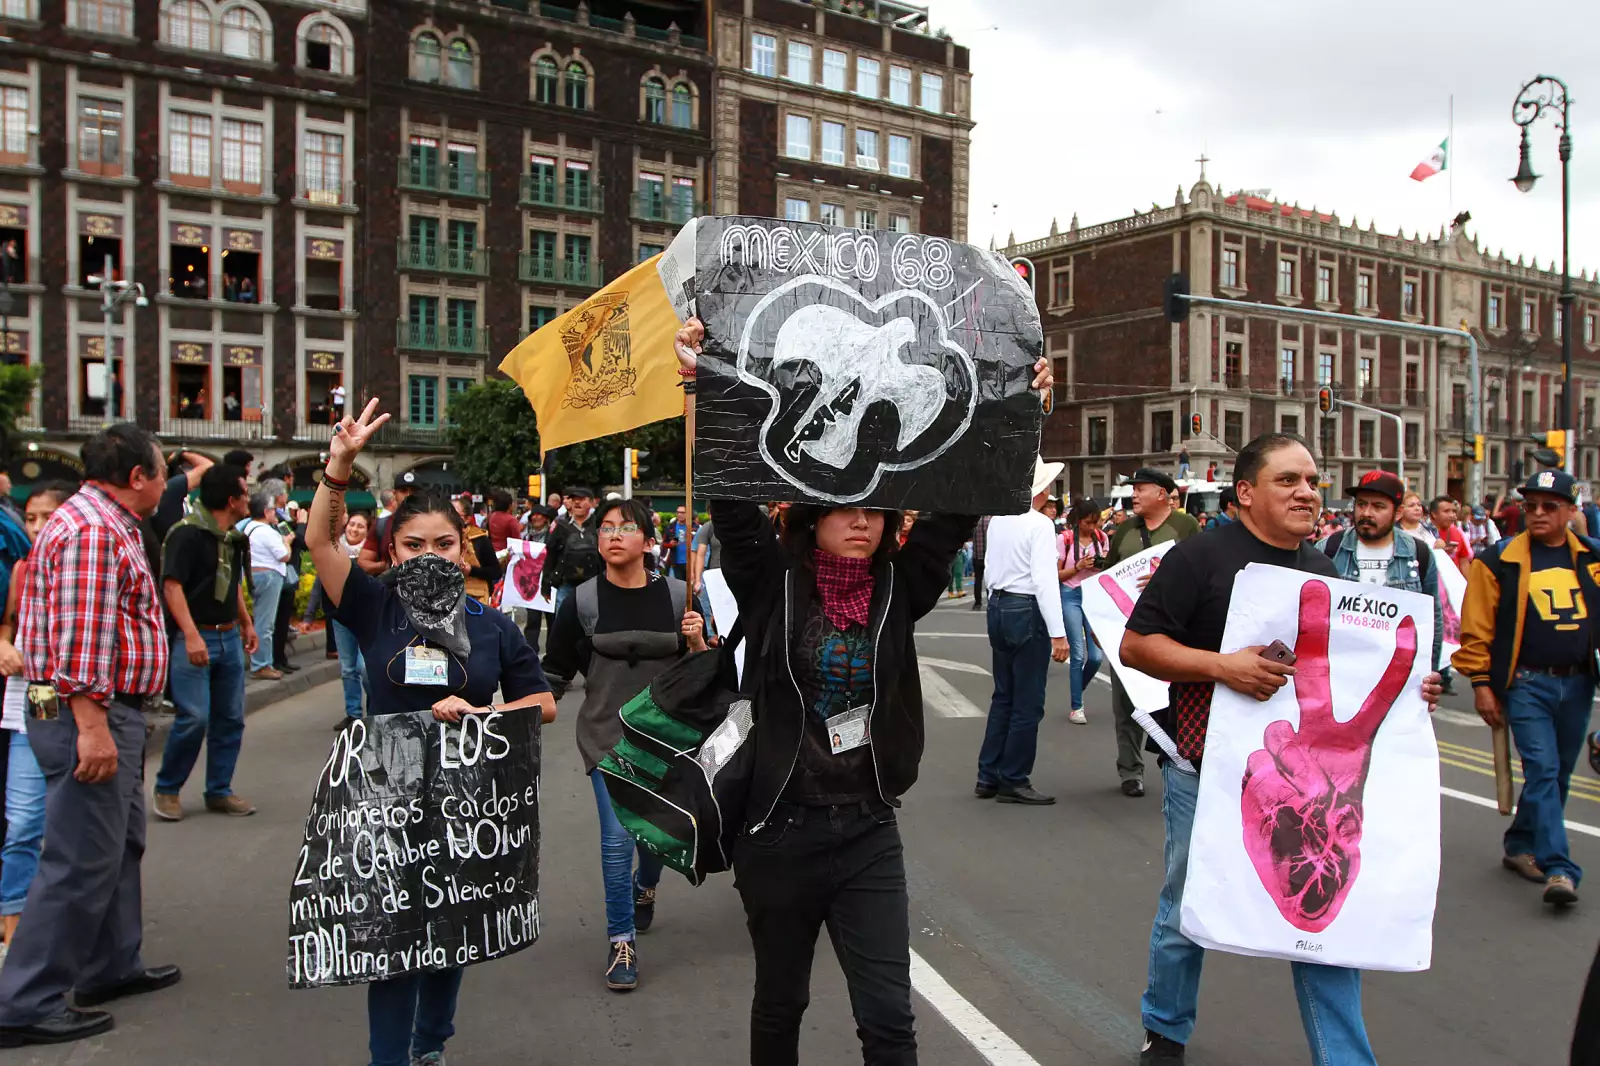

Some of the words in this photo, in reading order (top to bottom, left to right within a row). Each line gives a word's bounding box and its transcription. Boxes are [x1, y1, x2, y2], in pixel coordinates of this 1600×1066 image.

[720, 225, 879, 282] MEXICO
[891, 234, 954, 290] 68
[1337, 593, 1399, 619] MÉXICO
[1341, 613, 1390, 631] 1968-2018
[440, 711, 510, 769] LOS
[294, 844, 313, 886] 2
[319, 838, 344, 880] de
[352, 829, 441, 879] Octubre
[291, 881, 369, 925] minuto
[382, 875, 412, 914] de
[289, 923, 349, 983] TODA
[400, 921, 447, 970] vida
[456, 925, 479, 964] de
[483, 899, 540, 957] LUCHA
